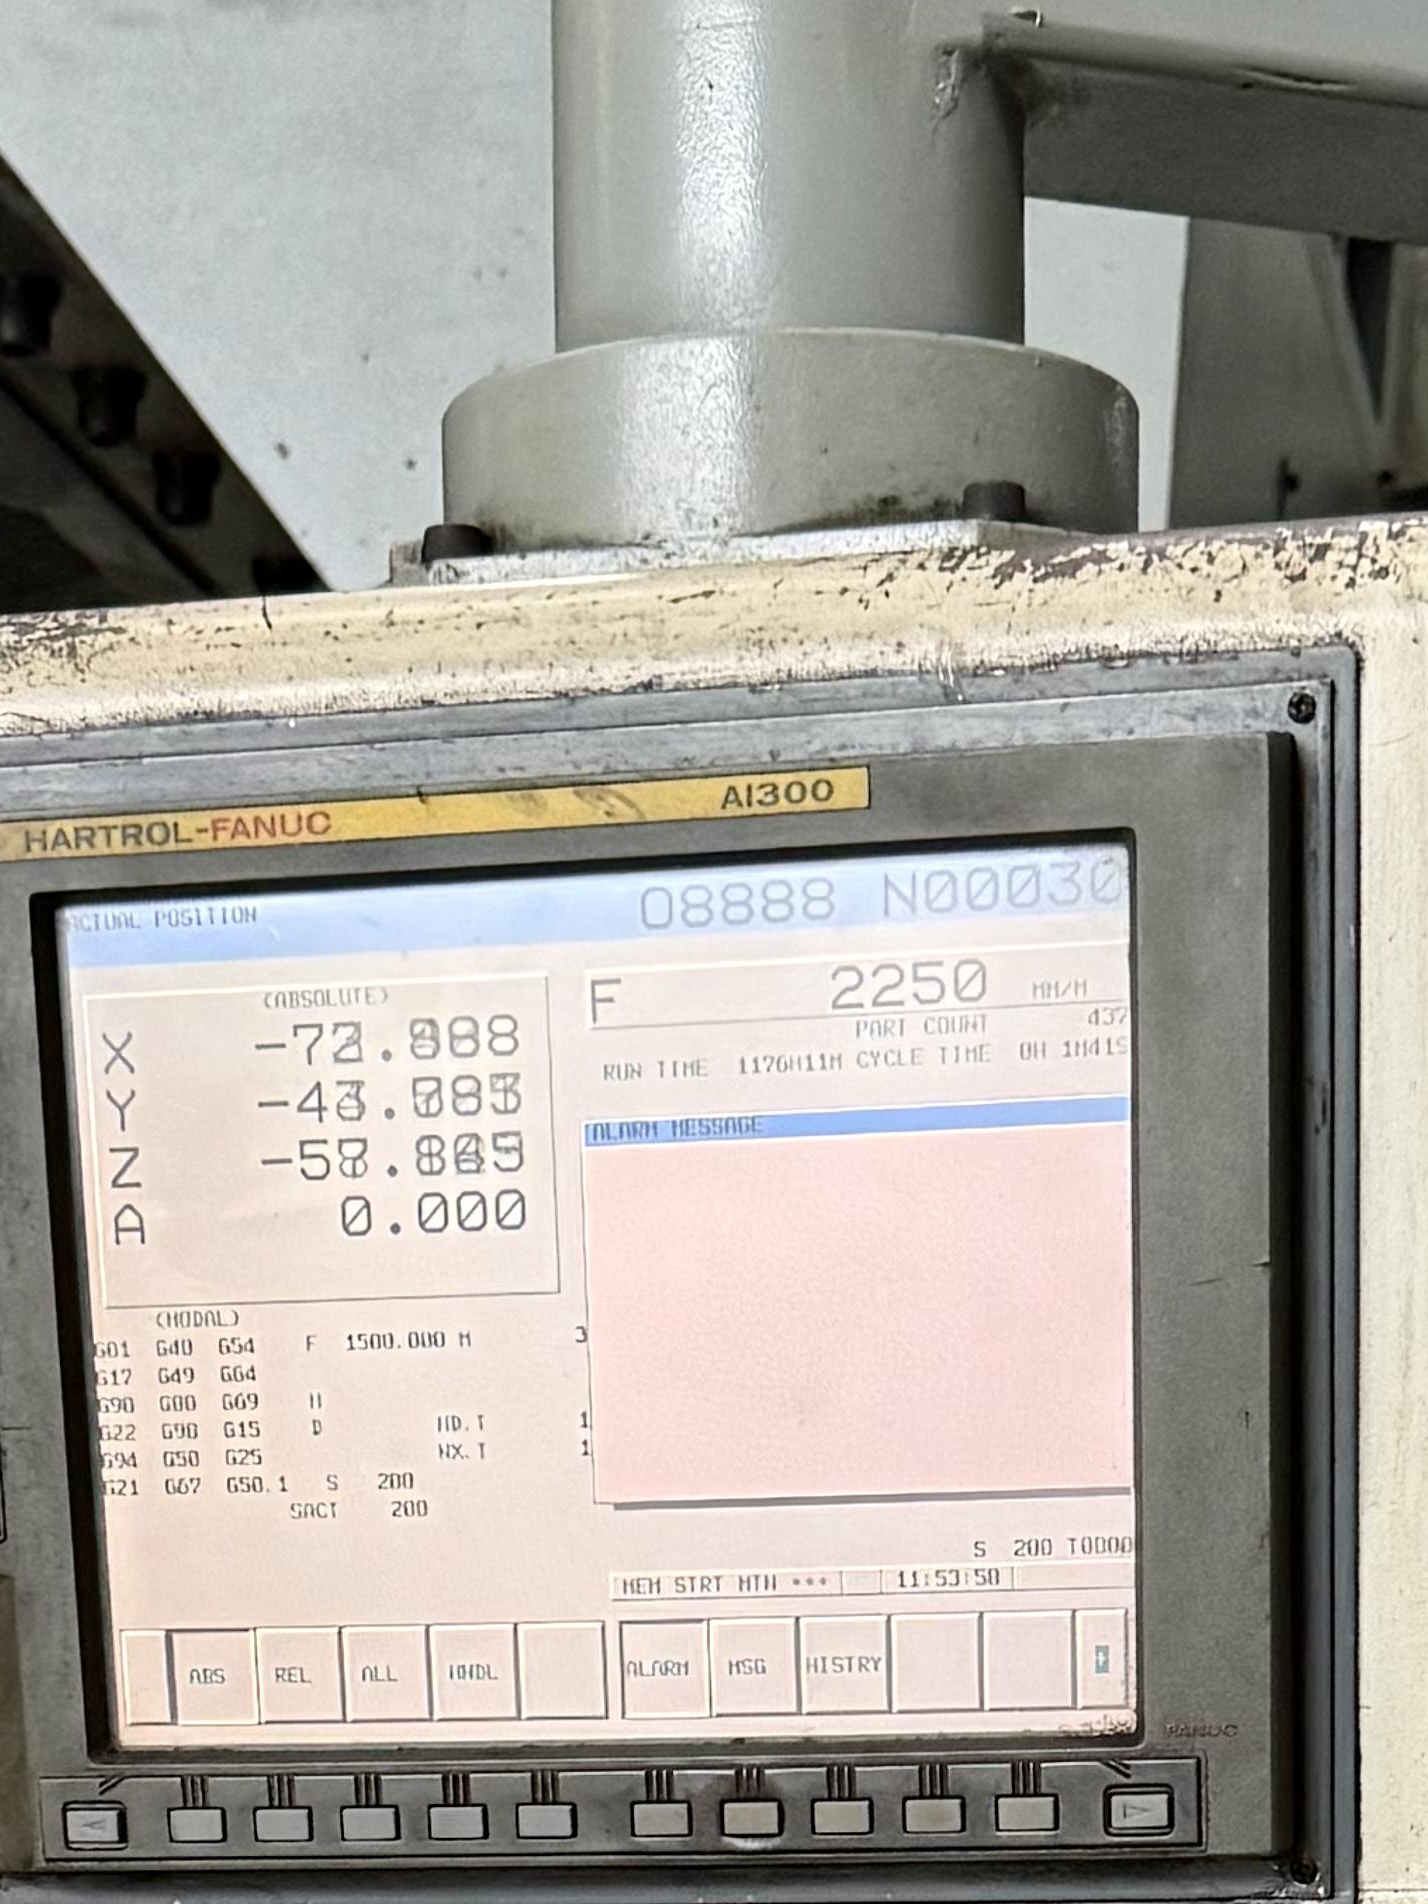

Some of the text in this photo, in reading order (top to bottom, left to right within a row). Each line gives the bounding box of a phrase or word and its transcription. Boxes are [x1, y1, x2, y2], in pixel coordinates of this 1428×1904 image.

[24, 811, 333, 854] HARTROL-FANUC
[882, 857, 1124, 918] N00030
[154, 906, 258, 929] POSITION
[263, 986, 389, 1010] (ABSOLUTE)
[589, 977, 622, 1025] F
[830, 957, 988, 1011] 2250
[855, 1018, 905, 1039] PART
[924, 1014, 988, 1036] COUNT
[102, 1031, 135, 1076] X
[603, 1062, 642, 1081] RUN
[657, 1058, 709, 1079] TIME
[856, 1047, 923, 1069] CYCLE
[939, 1044, 992, 1065] TIME
[106, 1090, 136, 1132] Y
[593, 1115, 765, 1142] ALARM MESSAGE
[110, 1146, 142, 1189] Z
[115, 1188, 526, 1246] A 0.000
[377, 1472, 414, 1490] 200
[392, 1500, 428, 1518] 200
[974, 1541, 987, 1558] S
[1013, 1538, 1053, 1557] 200
[675, 1575, 723, 1593] STRT
[189, 1668, 226, 1684] ABS
[274, 1666, 312, 1683] REL
[361, 1665, 398, 1682] ALL
[626, 1659, 690, 1678] ALARM
[728, 1658, 767, 1676] MSG
[806, 1656, 883, 1675] HISTRY
